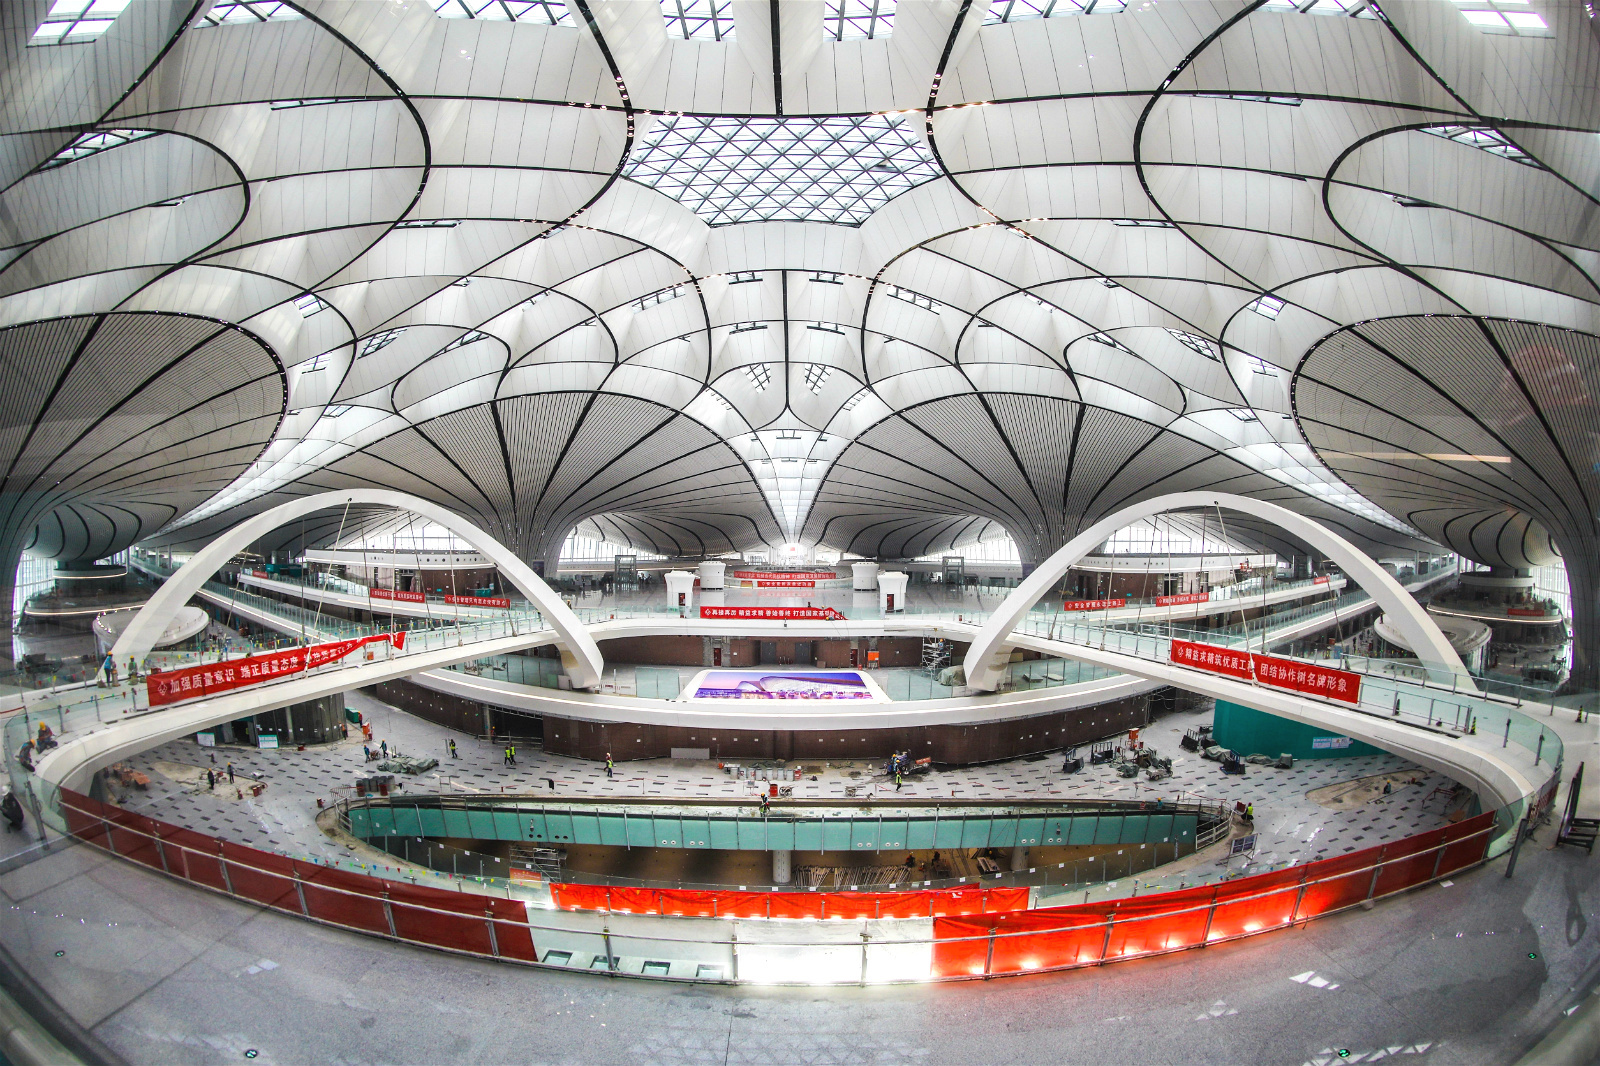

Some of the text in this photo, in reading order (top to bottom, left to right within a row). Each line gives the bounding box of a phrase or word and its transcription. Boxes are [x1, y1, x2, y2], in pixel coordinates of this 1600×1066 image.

[169, 668, 235, 694] 加强质量意识
[240, 655, 299, 679] 端正质量态度
[1184, 647, 1348, 693] 精益求精筑优质工程 团结协作树名牌形象
